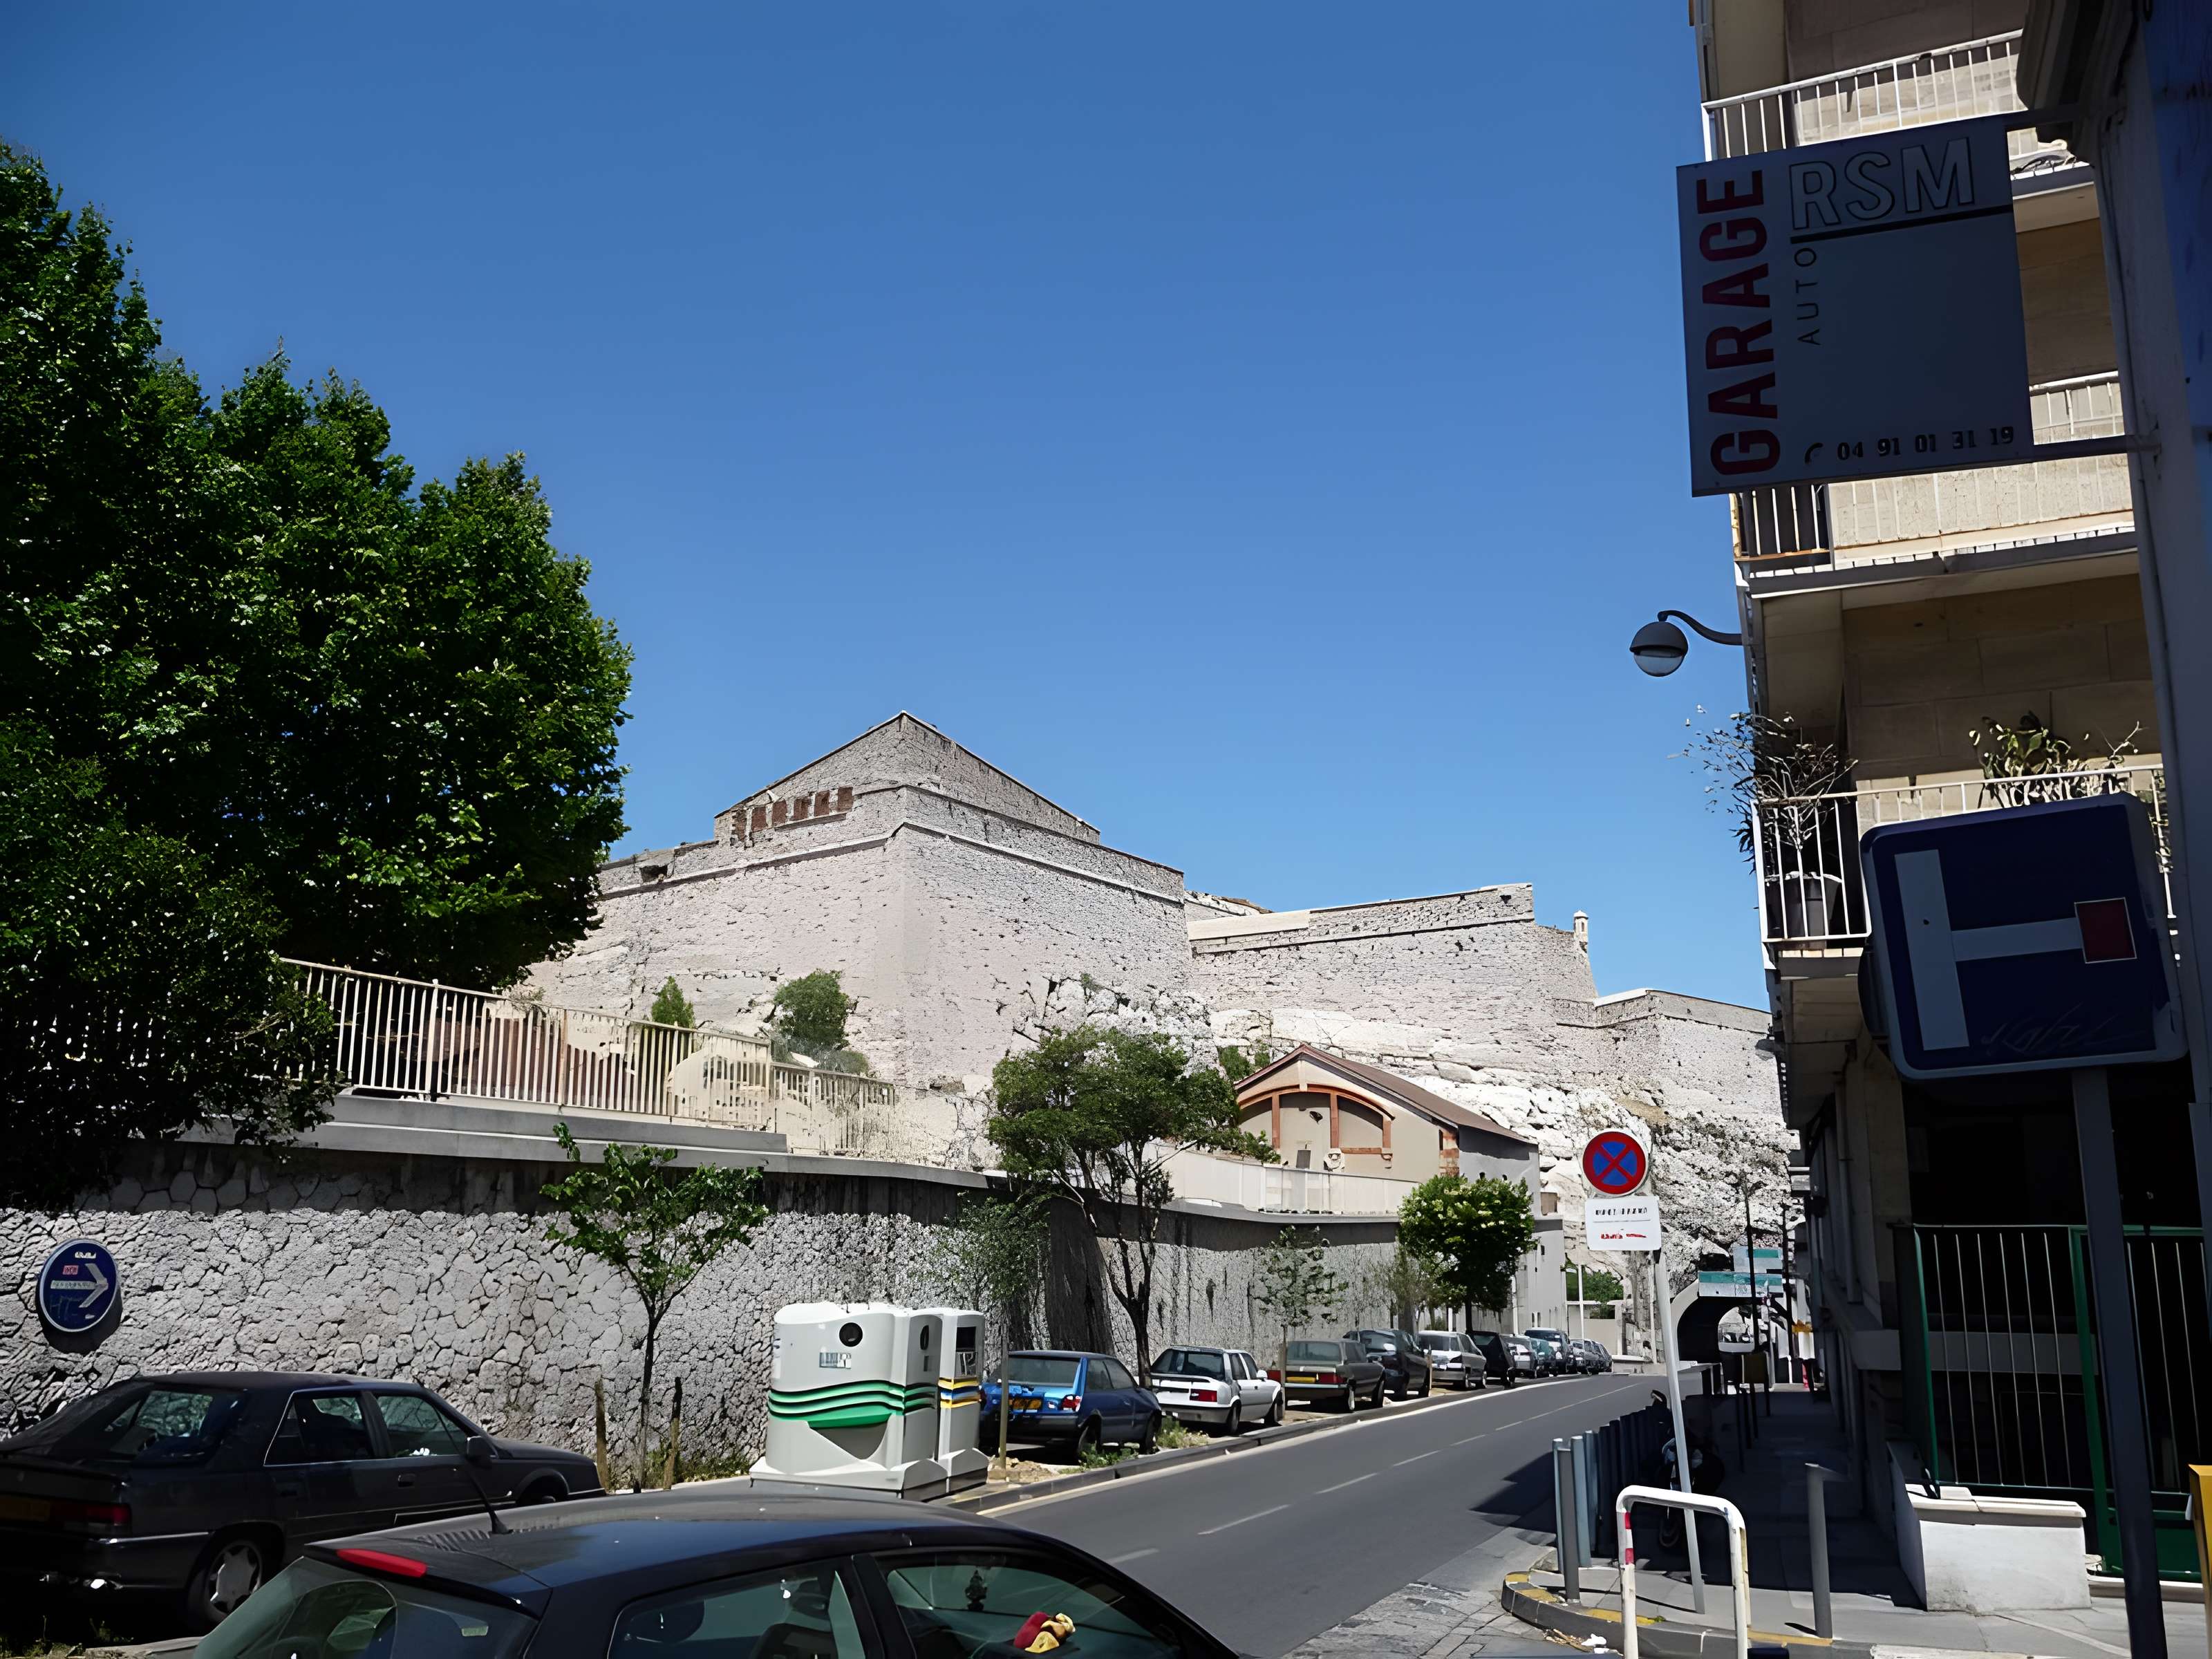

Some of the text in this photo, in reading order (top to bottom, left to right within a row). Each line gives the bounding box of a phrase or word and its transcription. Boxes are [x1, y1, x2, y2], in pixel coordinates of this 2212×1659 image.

[1789, 137, 1975, 229] RSM
[1696, 169, 1781, 476] GARAGE
[1794, 247, 1821, 346] AUTO
[1837, 427, 2014, 461] 04 91 01 31 19
